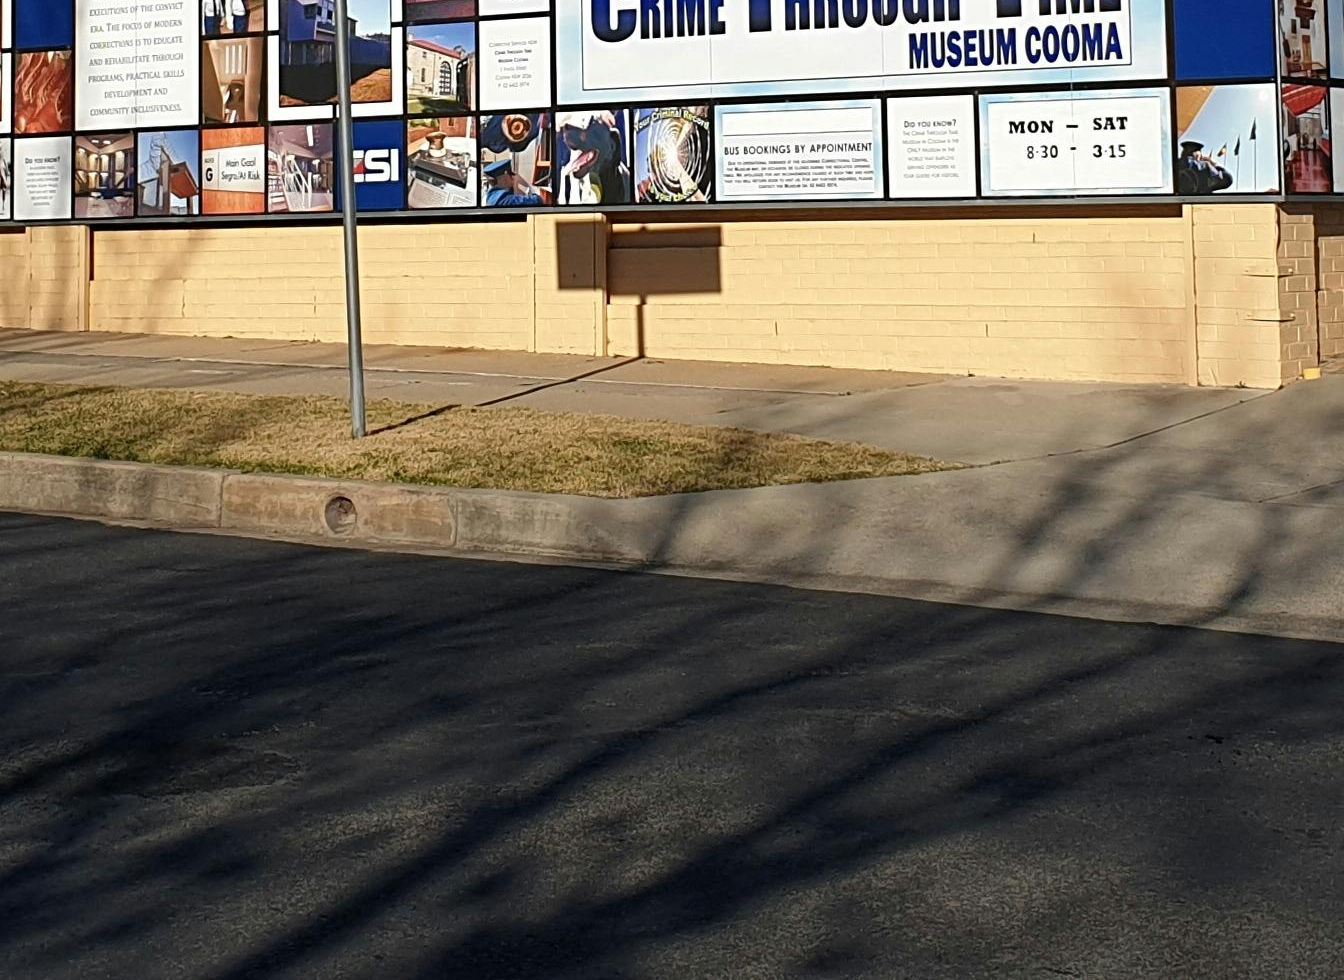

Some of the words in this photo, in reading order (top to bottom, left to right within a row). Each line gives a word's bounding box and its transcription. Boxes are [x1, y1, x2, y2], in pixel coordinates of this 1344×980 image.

[908, 28, 1017, 69] MUSEUM
[1025, 22, 1123, 64] COOMA
[651, 109, 681, 121] Criminal
[1009, 120, 1053, 134] MON
[1093, 116, 1128, 131] SAT
[724, 146, 739, 155] BUS
[743, 145, 791, 155] BOOKINGS
[795, 144, 805, 153] BY
[810, 142, 872, 152] APPOINTMENT
[206, 168, 213, 182] G
